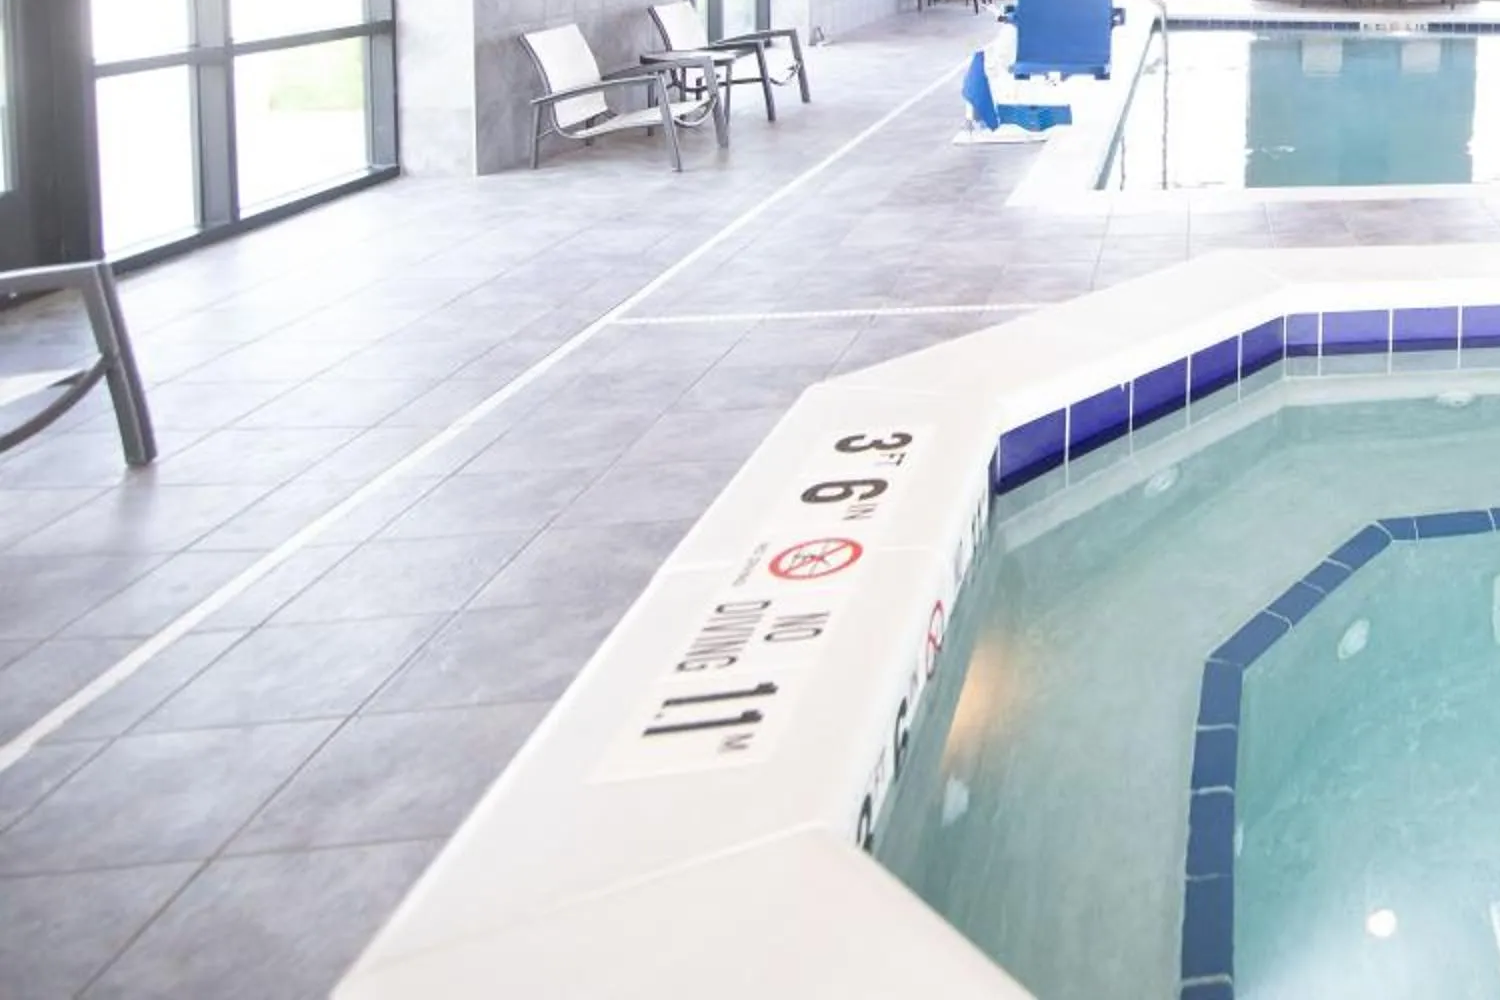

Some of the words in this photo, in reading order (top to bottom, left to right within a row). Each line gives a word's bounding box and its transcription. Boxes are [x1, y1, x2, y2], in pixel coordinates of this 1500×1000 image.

[834, 432, 913, 453] 3
[800, 478, 889, 504] 6
[675, 599, 772, 673] DIVING
[764, 611, 832, 643] NO
